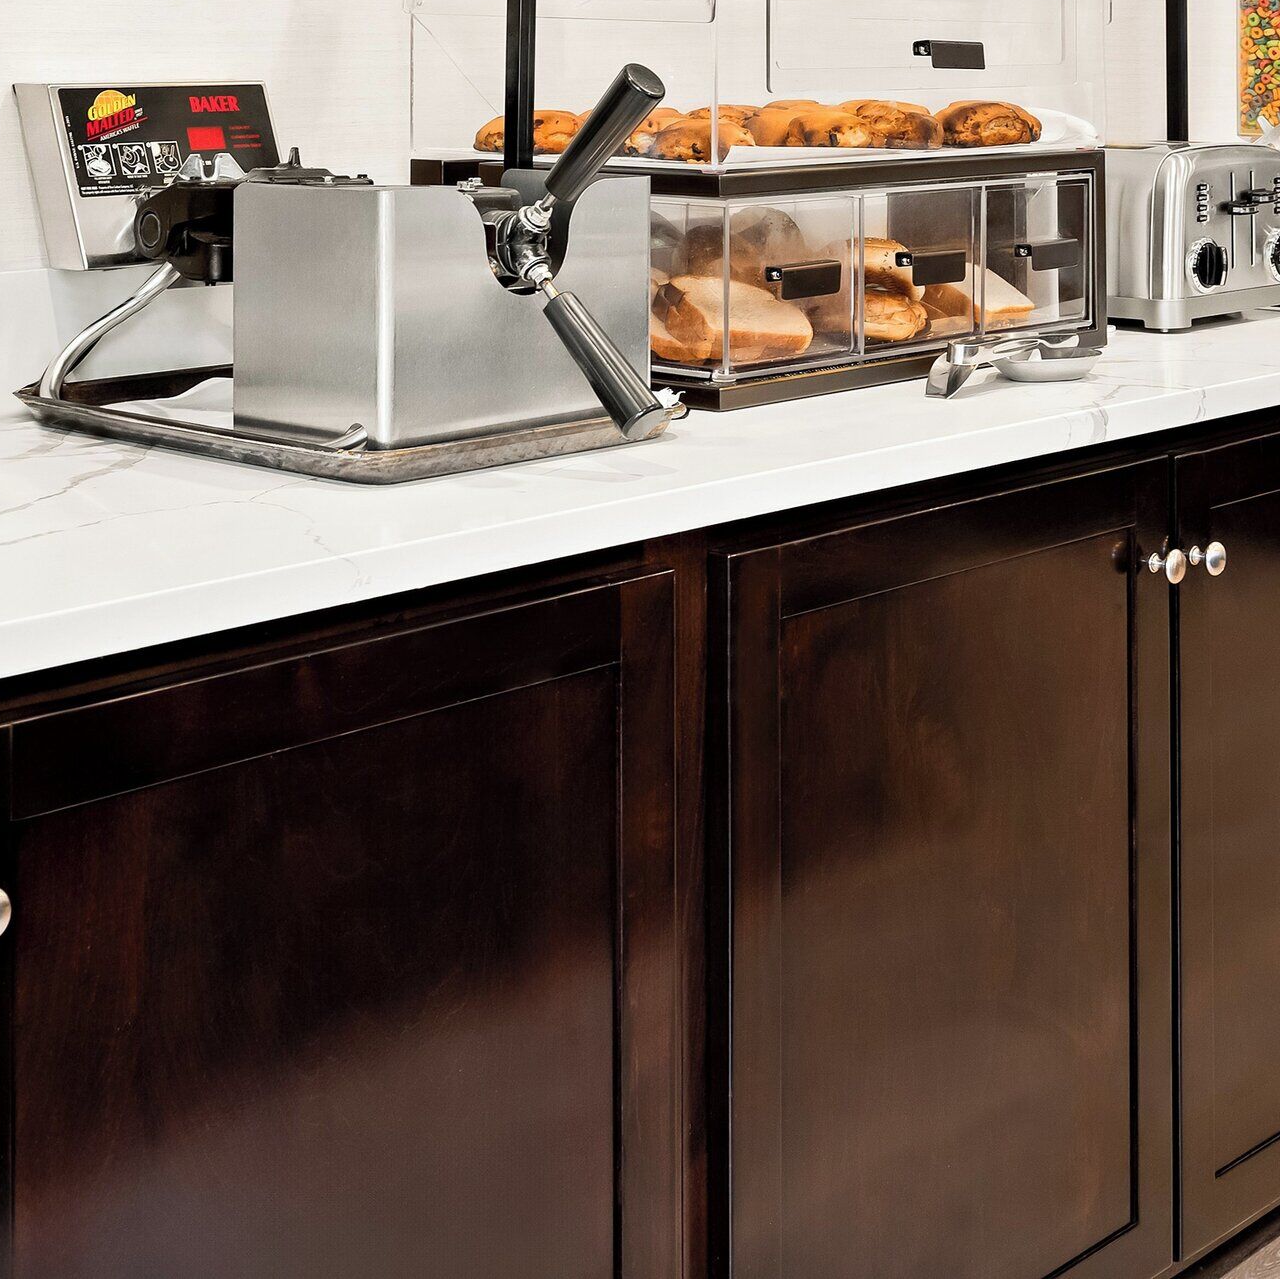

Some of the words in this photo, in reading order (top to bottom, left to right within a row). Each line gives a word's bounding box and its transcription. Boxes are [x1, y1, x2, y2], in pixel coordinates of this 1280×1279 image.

[88, 94, 136, 121] GOLDEN
[190, 96, 240, 113] BAKER
[86, 106, 135, 138] MALTED
